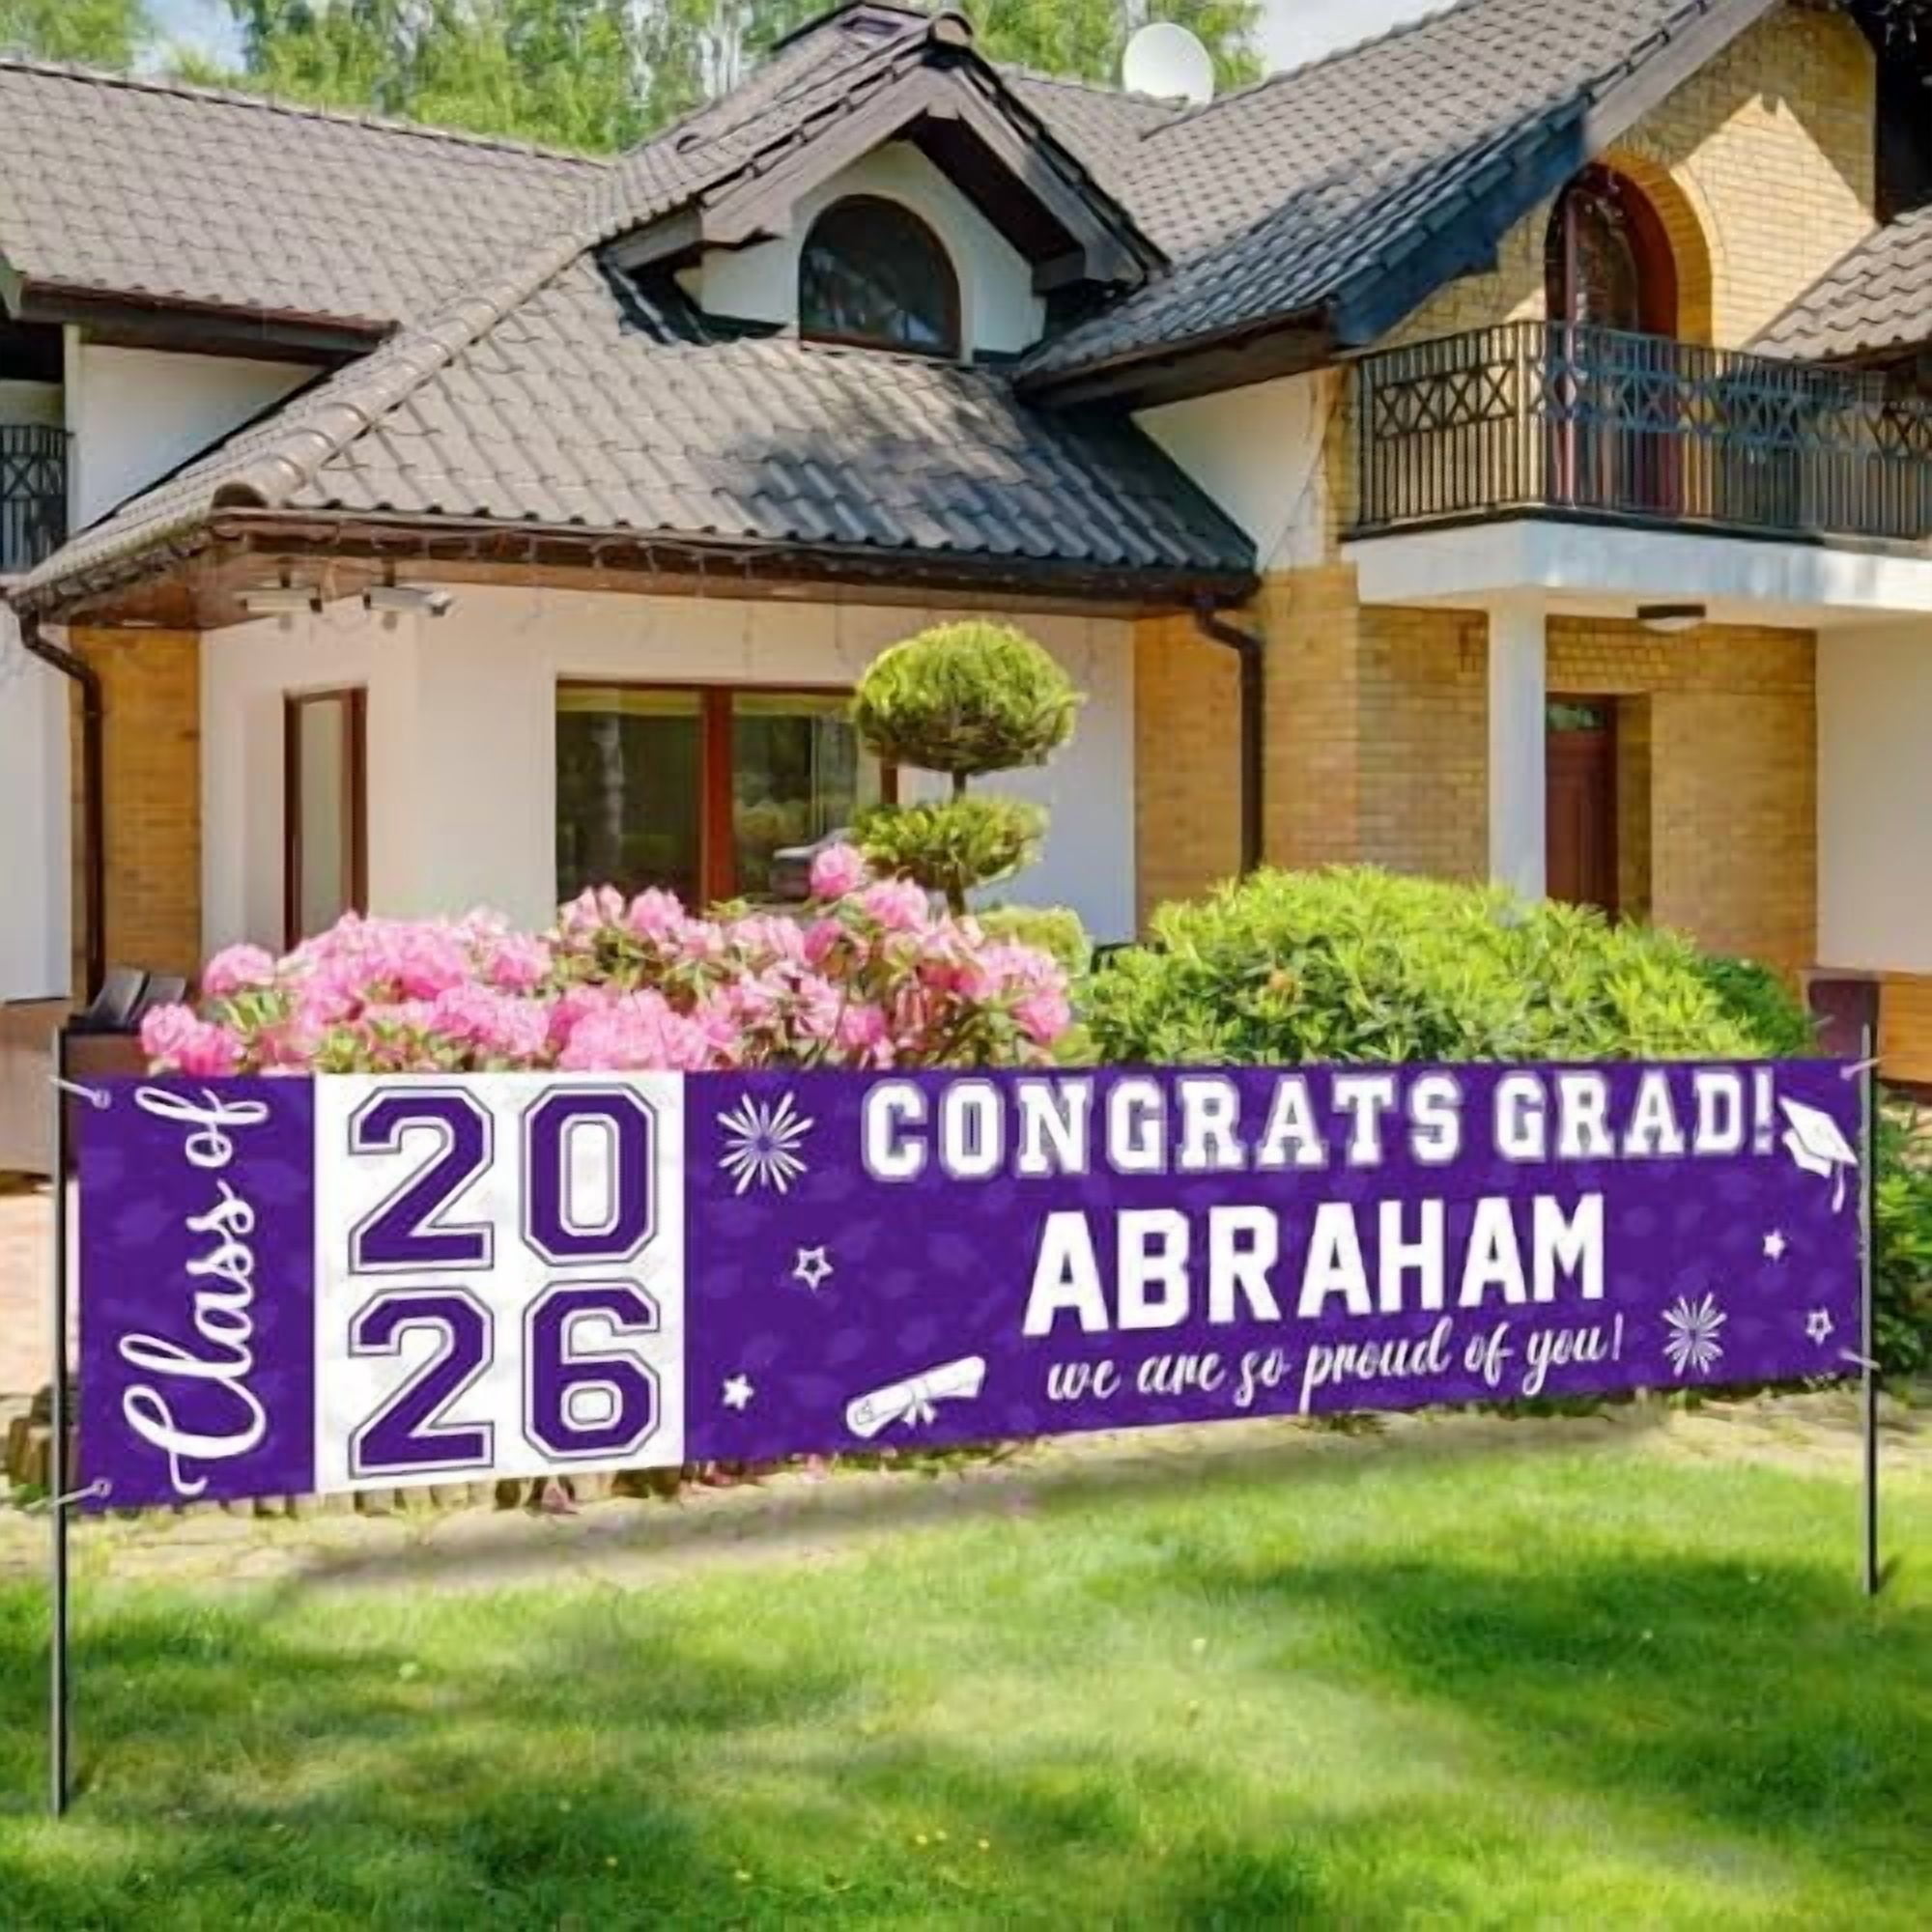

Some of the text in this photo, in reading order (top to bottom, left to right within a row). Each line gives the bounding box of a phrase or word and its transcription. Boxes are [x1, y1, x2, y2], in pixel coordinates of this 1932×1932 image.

[348, 1084, 660, 1275] 20
[861, 1068, 1776, 1180] CONGRATS GRAD!
[118, 1086, 270, 1496] Class of
[1022, 1192, 1605, 1337] ABRAHAM
[348, 1280, 662, 1480] 26
[1046, 1312, 1626, 1416] we are so proud of you!
